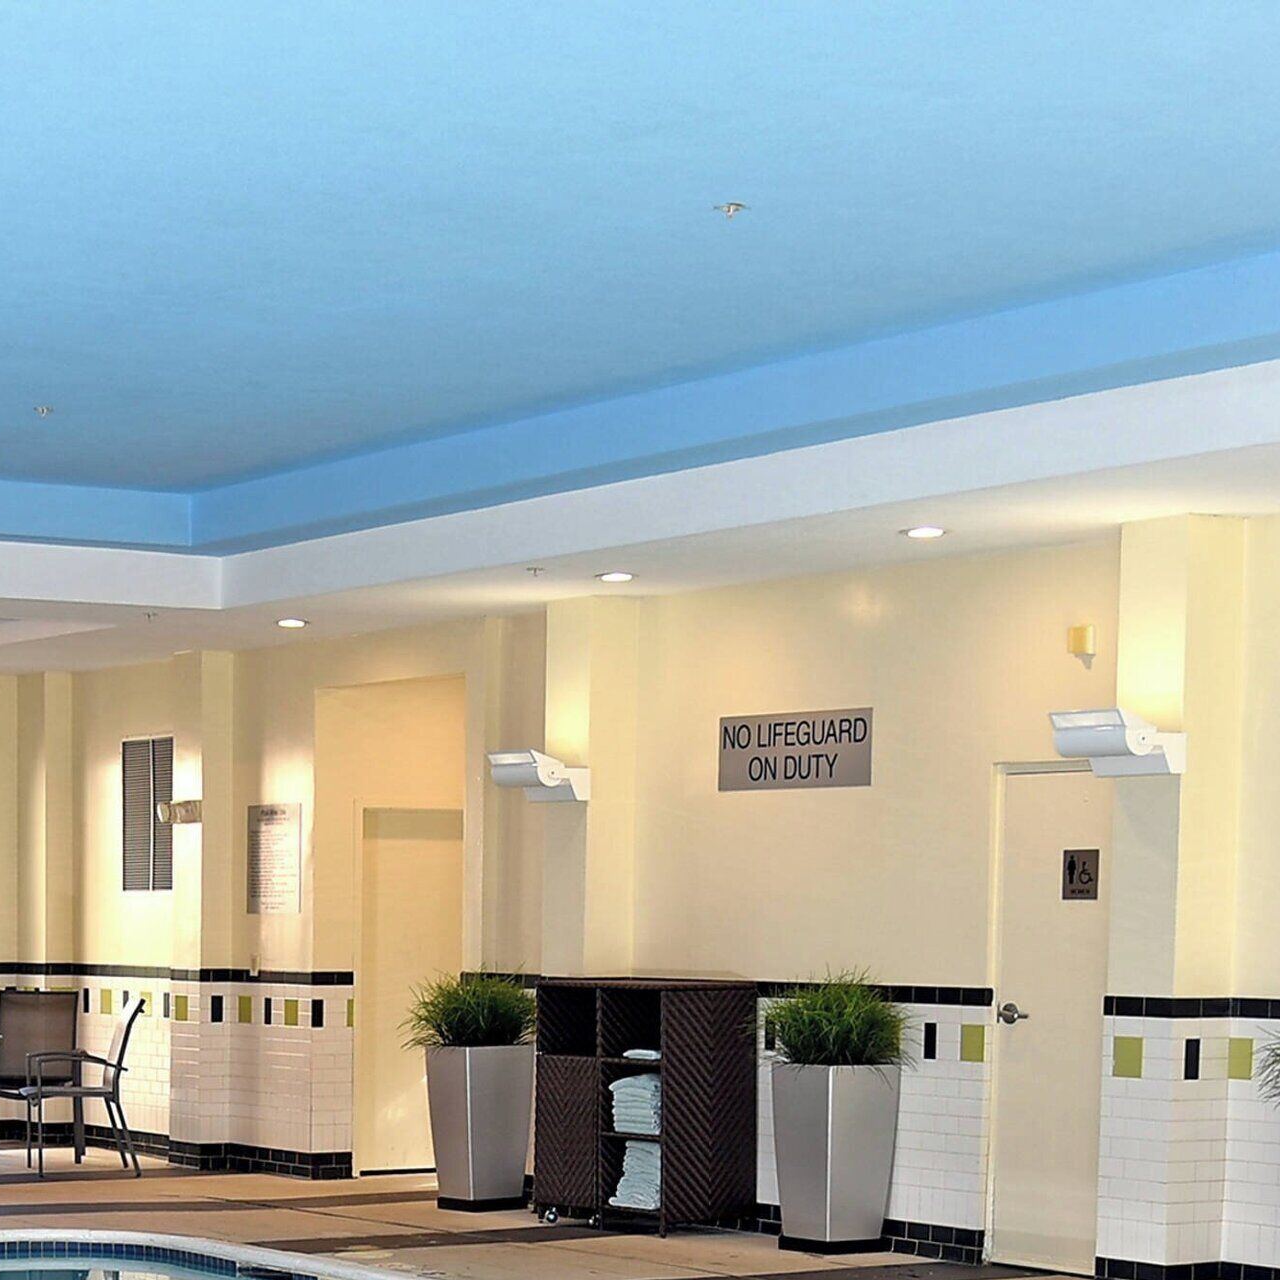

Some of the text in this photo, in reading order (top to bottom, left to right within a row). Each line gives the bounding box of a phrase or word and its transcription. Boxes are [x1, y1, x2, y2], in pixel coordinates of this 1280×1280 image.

[723, 717, 867, 749] NO LIFEGUARD
[748, 753, 838, 781] ON DUTY
